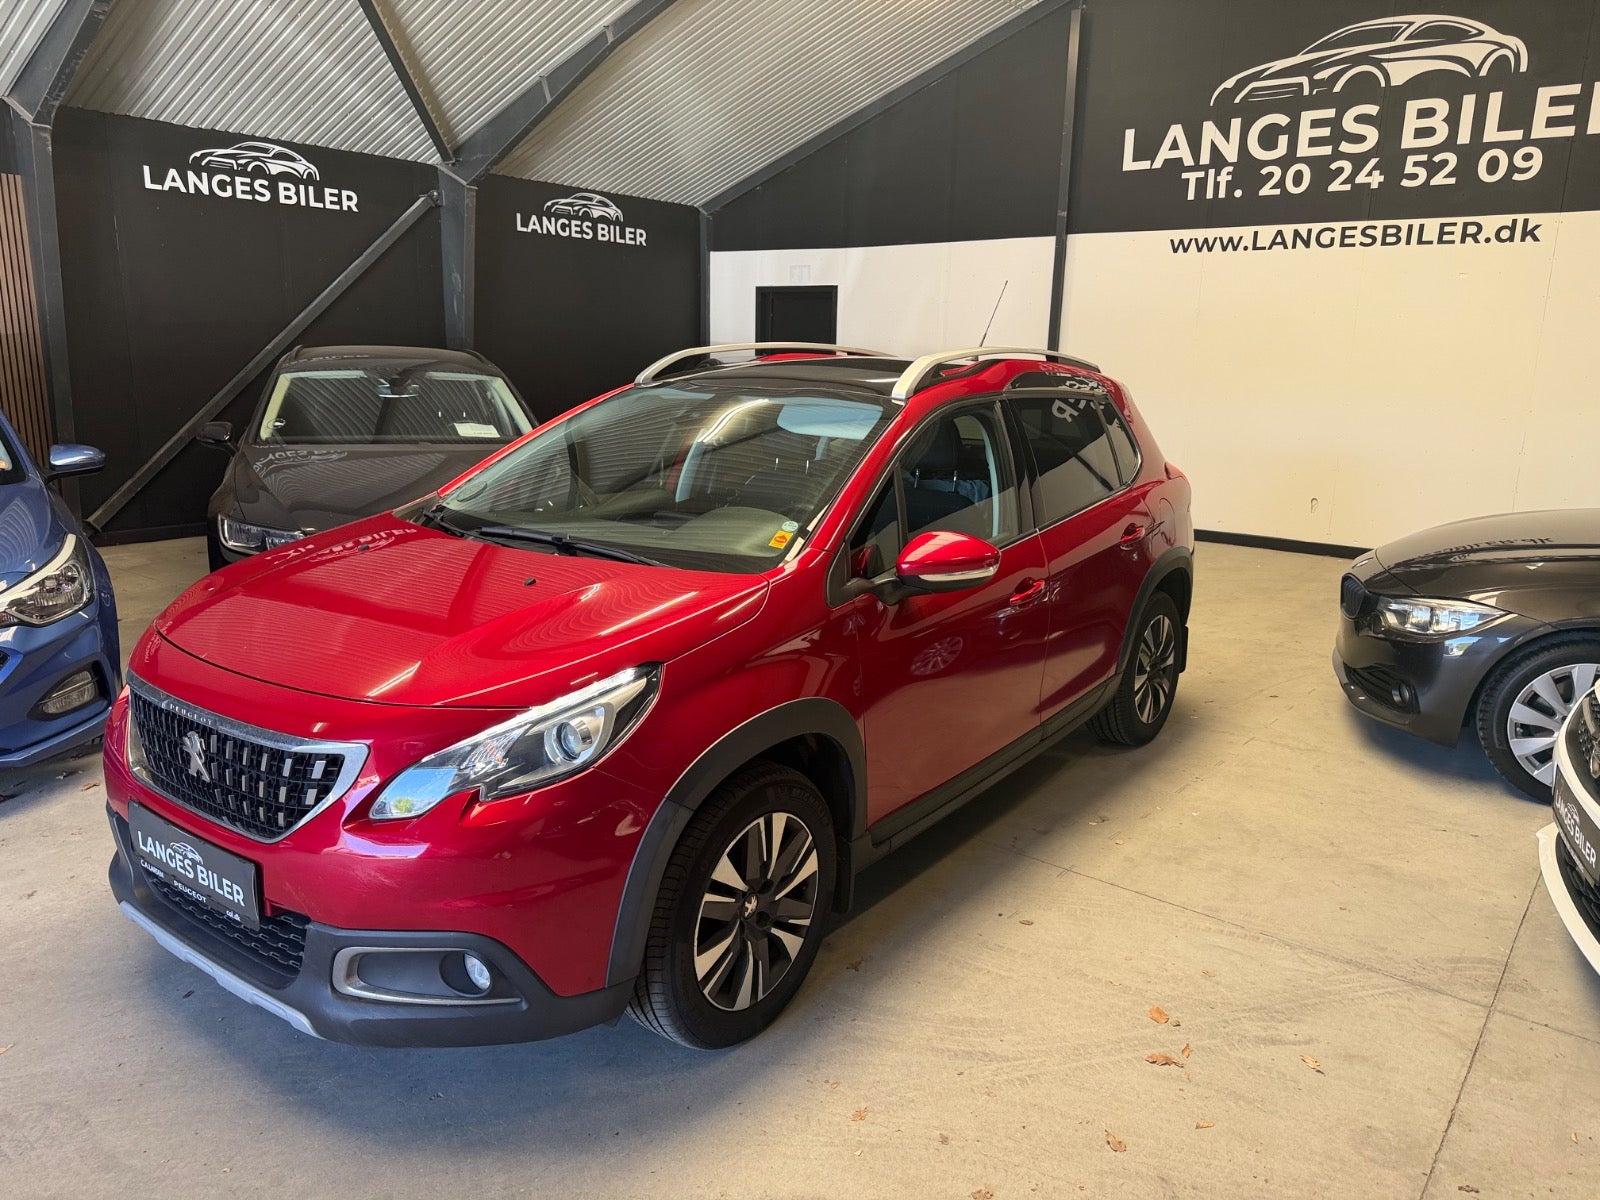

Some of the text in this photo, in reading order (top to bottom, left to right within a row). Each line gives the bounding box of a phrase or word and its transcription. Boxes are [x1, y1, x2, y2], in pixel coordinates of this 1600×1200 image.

[1122, 103, 1381, 172] LANGES
[142, 164, 359, 213] LANGES BILER
[1181, 146, 1543, 201] Tlf. 20 24 52 09
[516, 212, 647, 247] LANGES BILER
[1169, 218, 1542, 254] www.LANGESBILER.dk
[137, 830, 194, 879] LANGES
[196, 863, 245, 907] BILER
[1574, 825, 1597, 869] BILER
[173, 879, 207, 903] PEUGEOT
